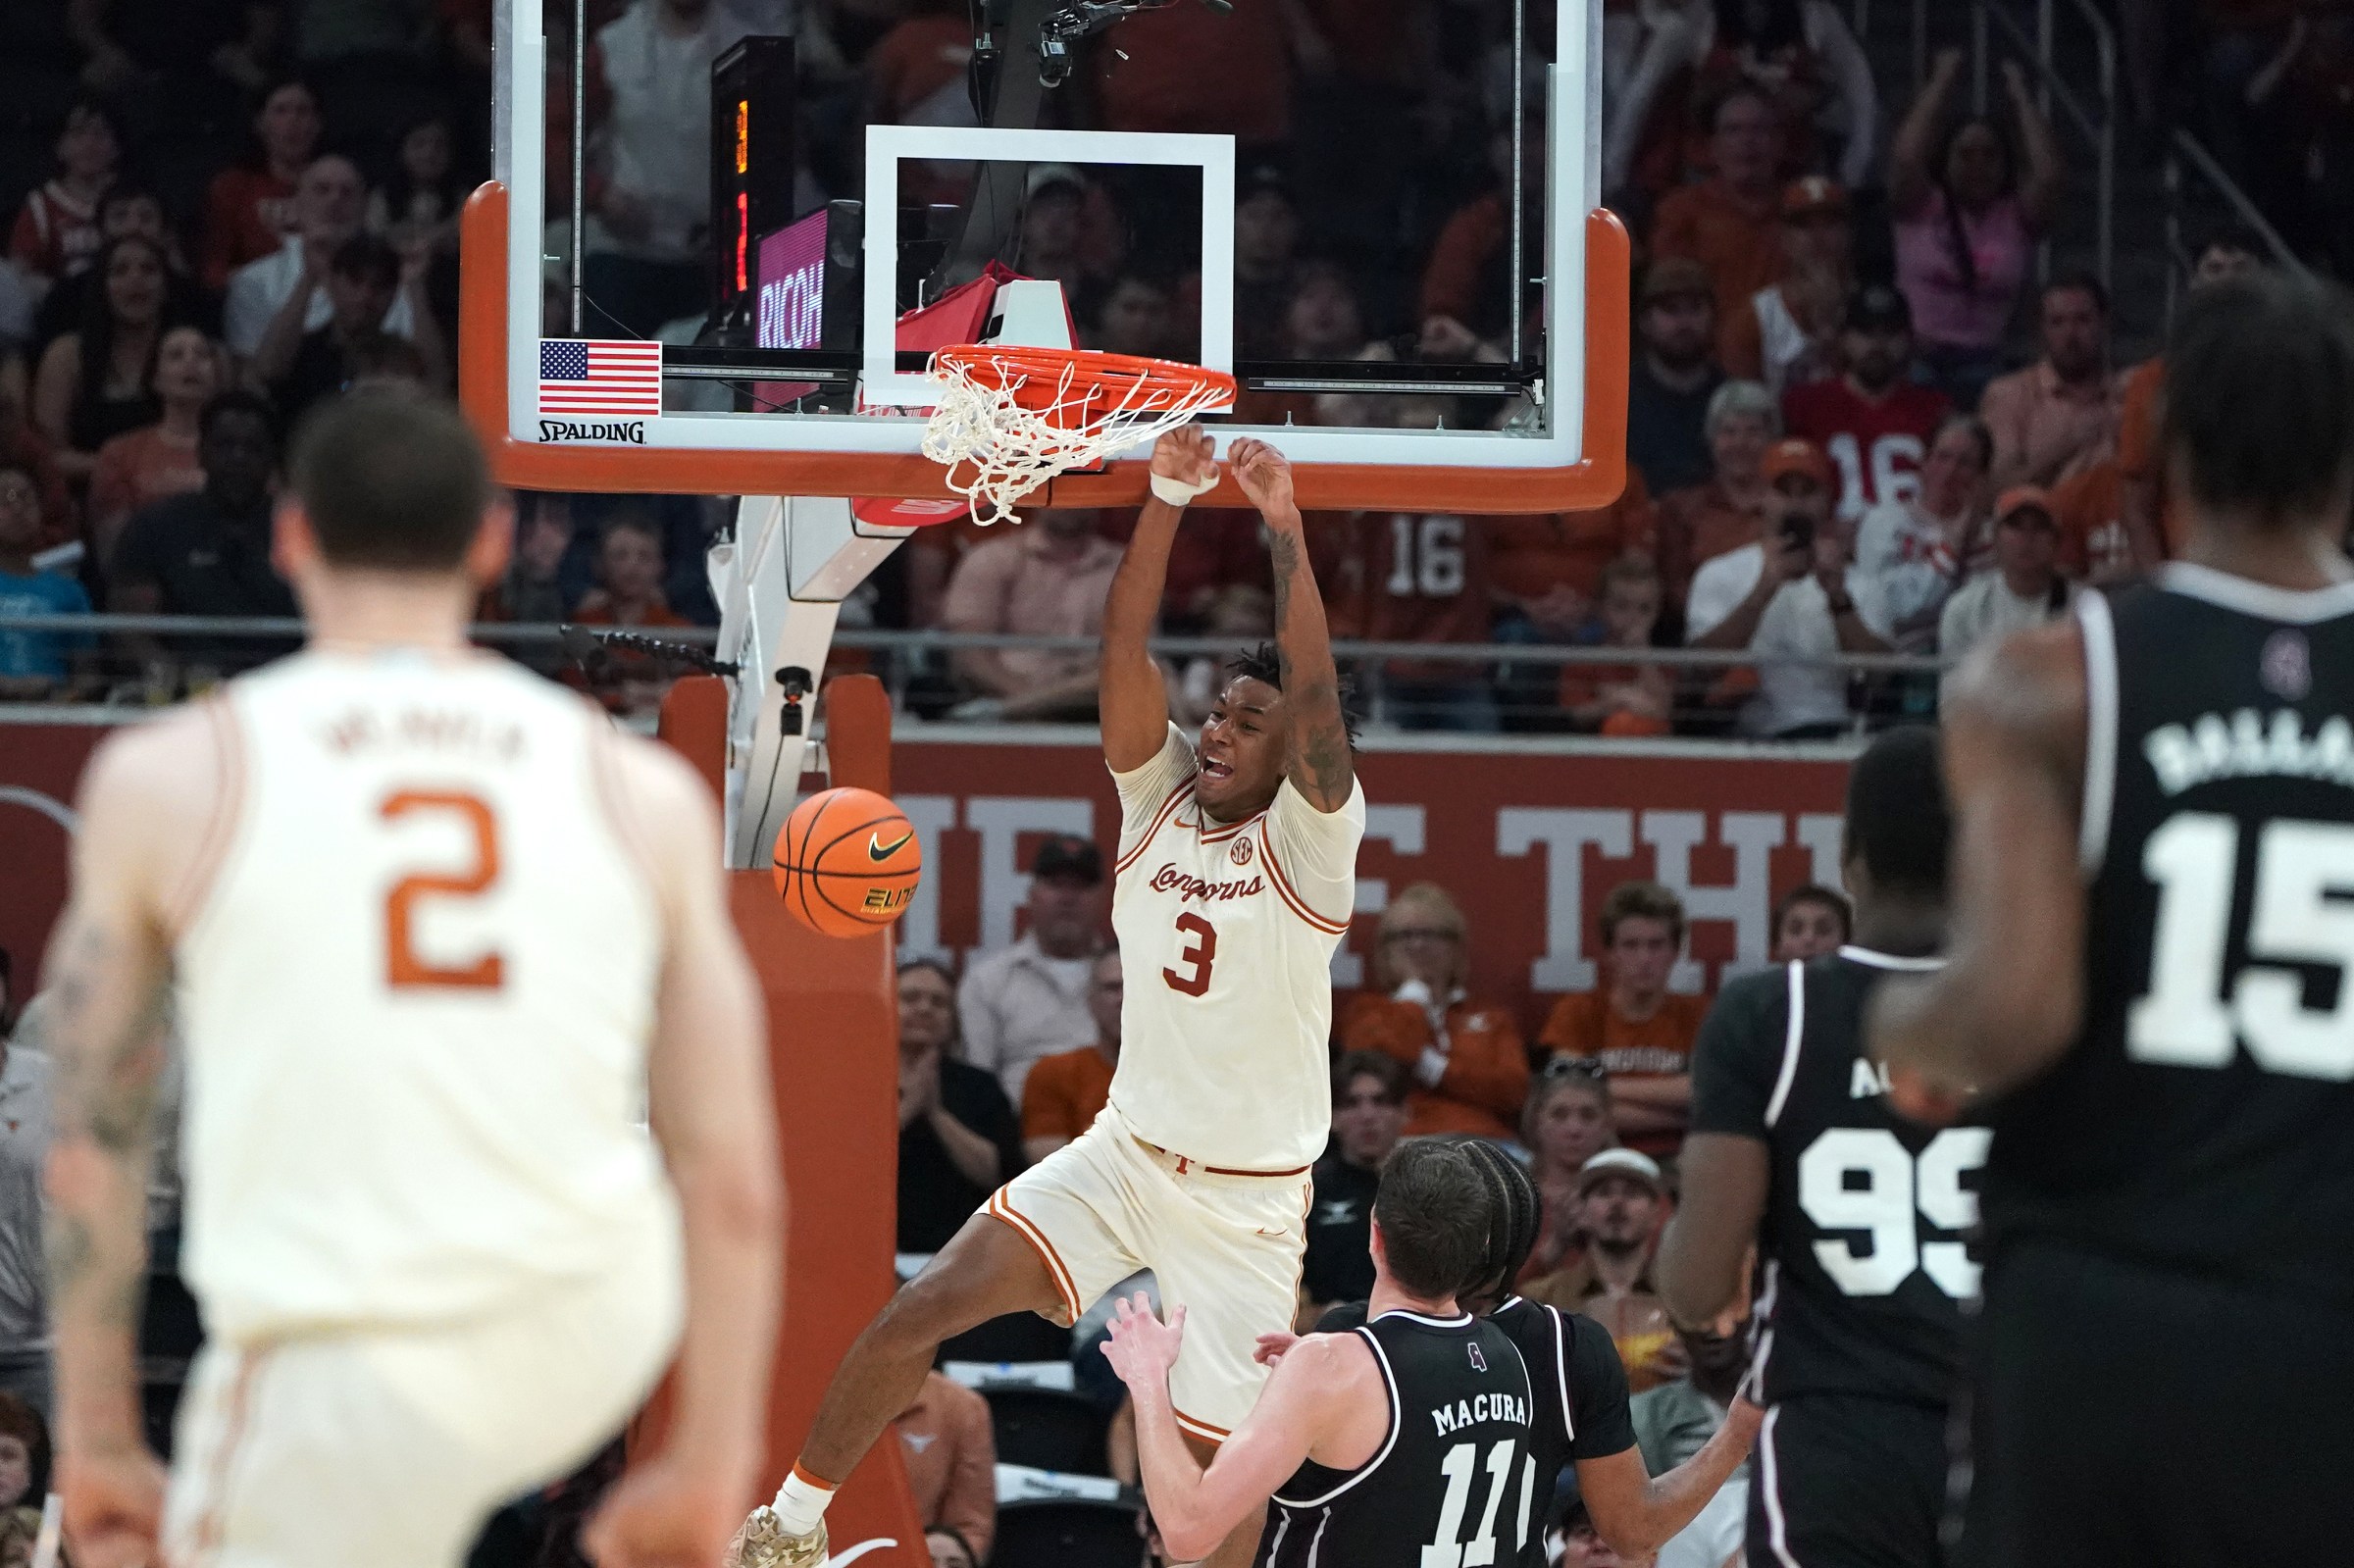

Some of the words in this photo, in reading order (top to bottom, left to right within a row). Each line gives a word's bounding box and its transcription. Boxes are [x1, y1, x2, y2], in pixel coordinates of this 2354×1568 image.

[759, 260, 824, 348] RICOH
[538, 420, 647, 444] SPALDING
[1389, 515, 1466, 597] 16
[379, 788, 502, 988] 2
[1150, 863, 1265, 902] Longorns
[1231, 837, 1253, 864] SEC
[1162, 911, 1217, 997] 3
[2124, 810, 2354, 1079] 15
[1431, 1393, 1526, 1438] MACURA
